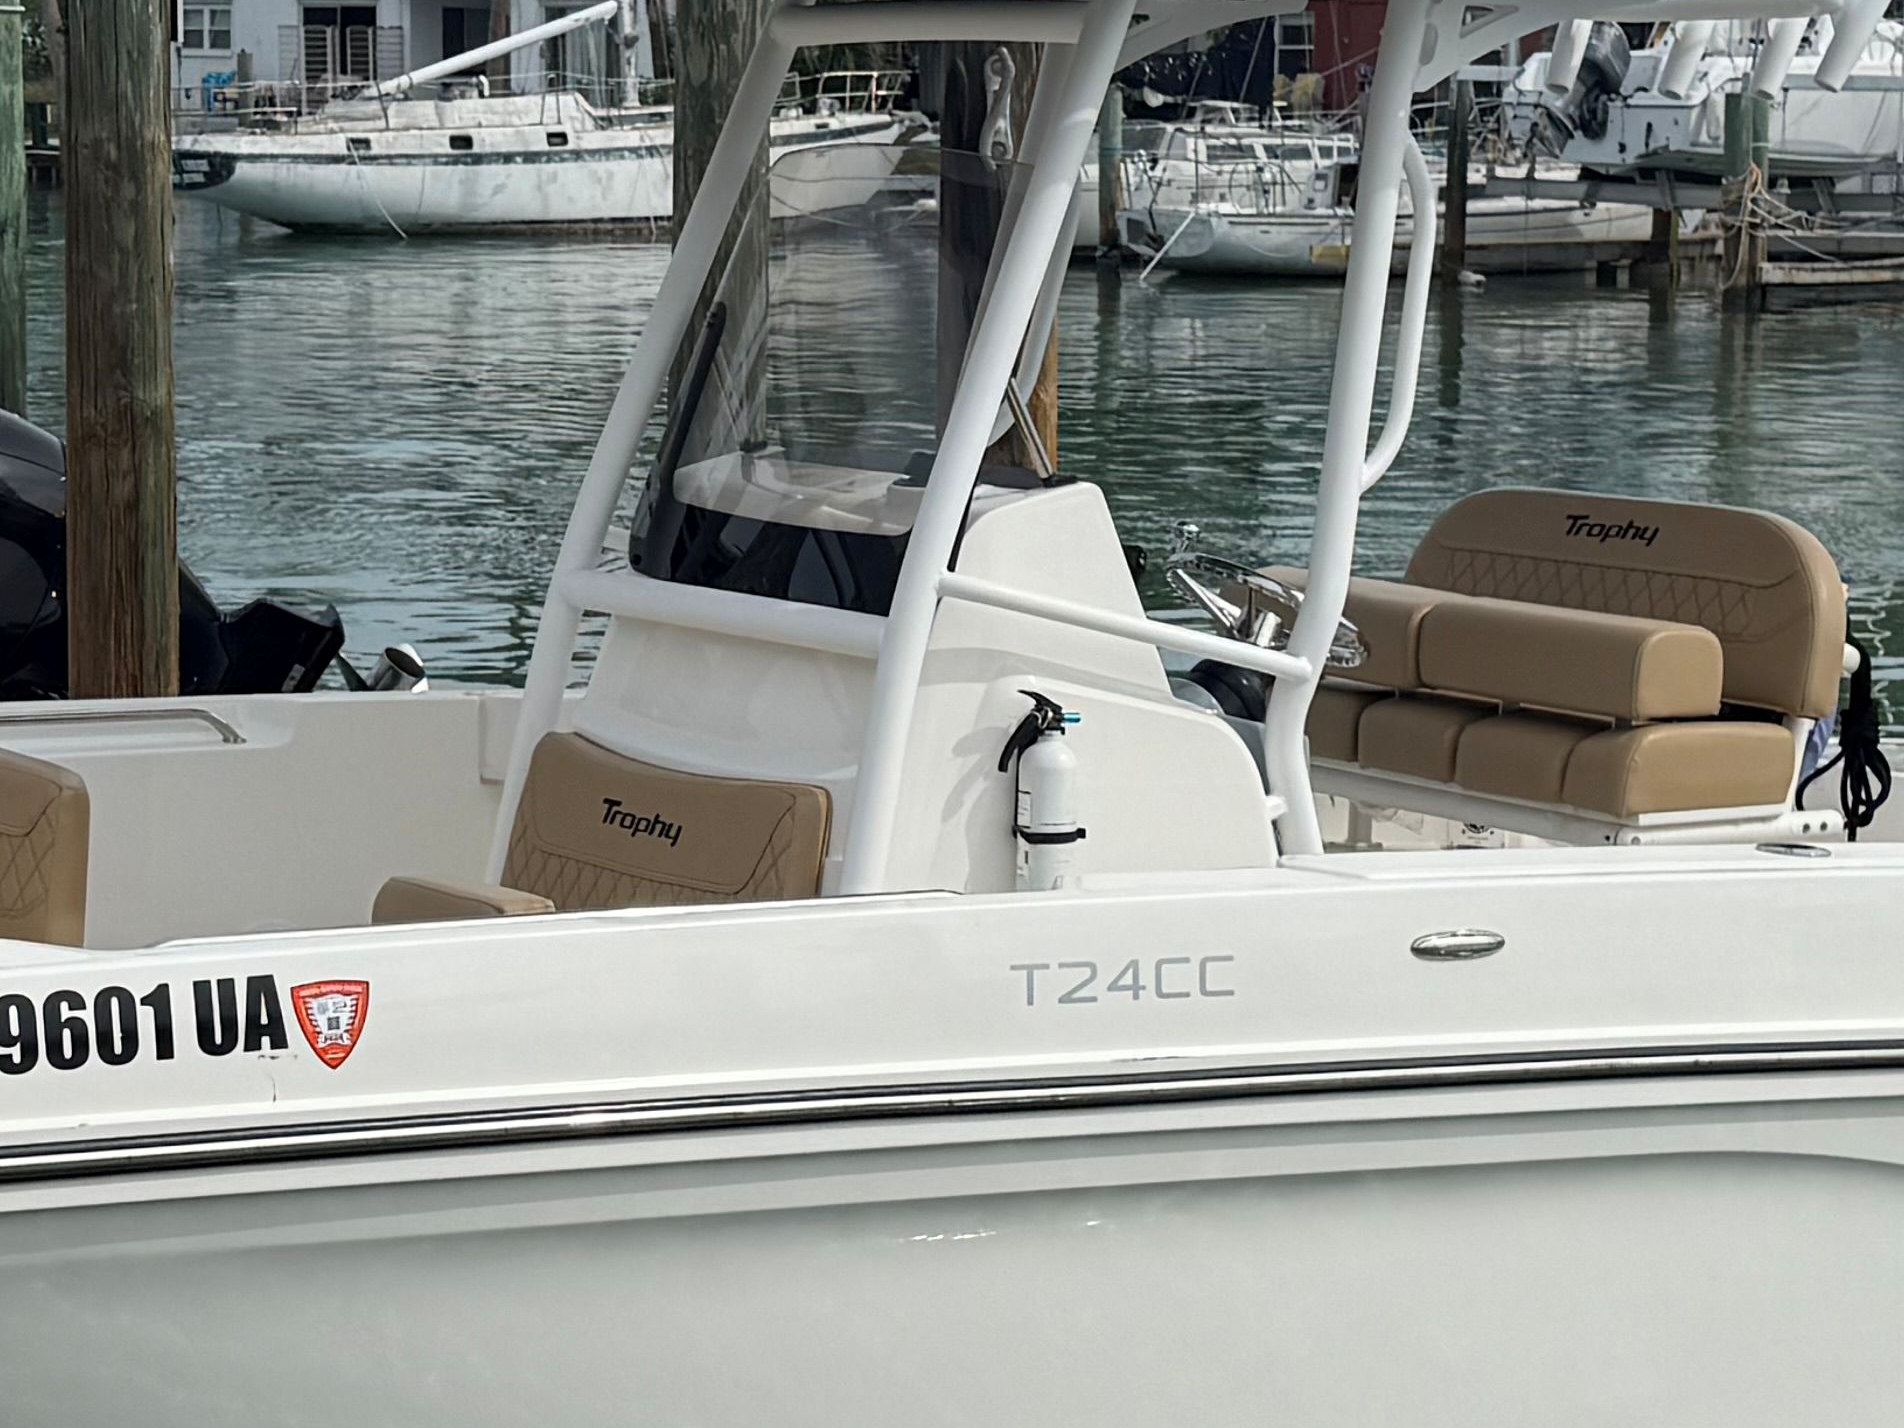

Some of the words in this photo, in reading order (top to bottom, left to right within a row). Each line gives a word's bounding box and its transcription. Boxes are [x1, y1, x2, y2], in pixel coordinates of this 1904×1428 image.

[1566, 514, 1660, 548] Trophy
[602, 797, 683, 848] Trophy
[1009, 954, 1236, 1007] T24CC
[192, 974, 290, 1057] UA
